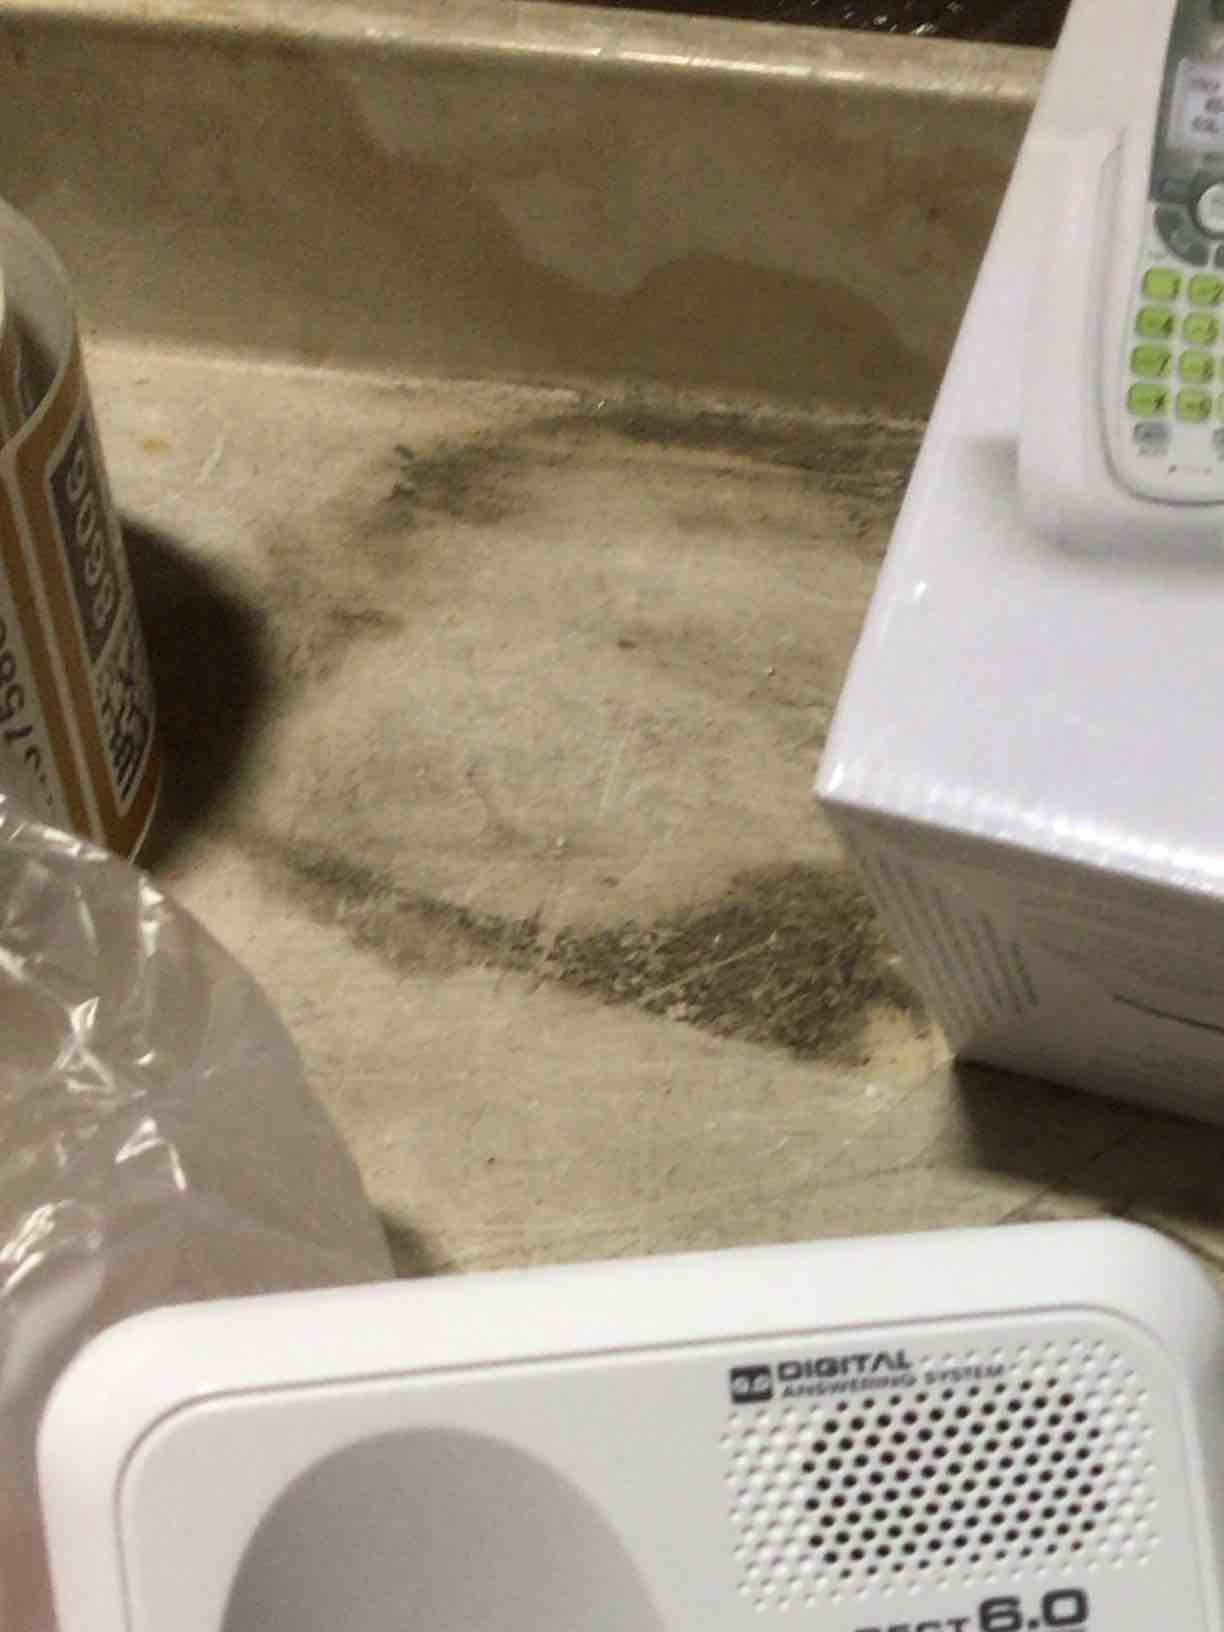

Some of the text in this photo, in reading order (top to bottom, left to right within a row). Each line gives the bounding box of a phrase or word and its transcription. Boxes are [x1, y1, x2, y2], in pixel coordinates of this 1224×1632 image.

[777, 1349, 912, 1382] DIGITAL
[782, 1364, 1005, 1399] ANSWERING SYSTEM
